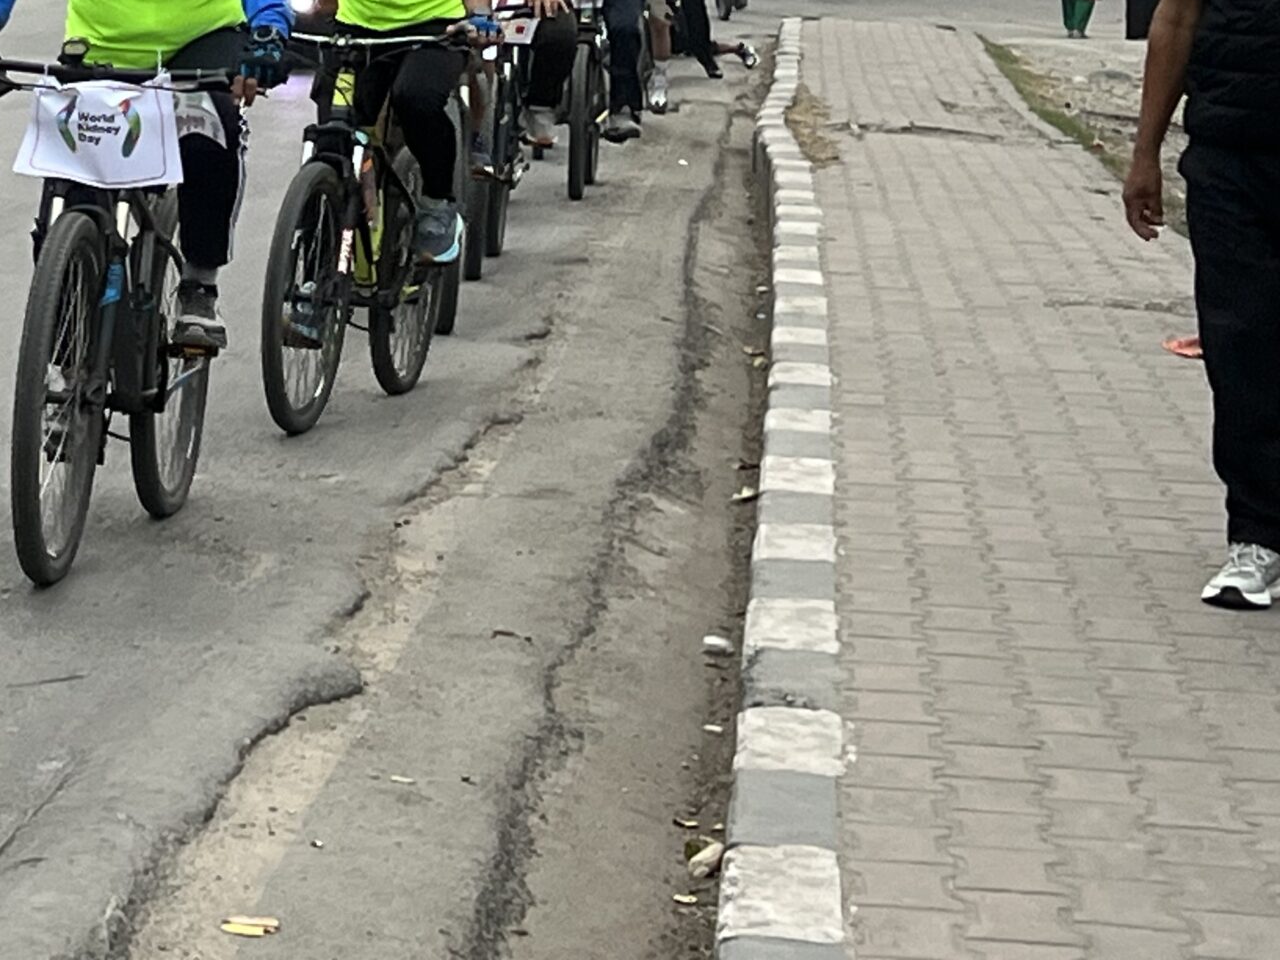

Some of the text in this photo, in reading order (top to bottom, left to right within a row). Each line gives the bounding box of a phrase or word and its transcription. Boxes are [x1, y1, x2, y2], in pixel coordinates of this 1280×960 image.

[78, 111, 115, 123] World
[78, 123, 121, 136] Kidney
[78, 133, 102, 146] Day
